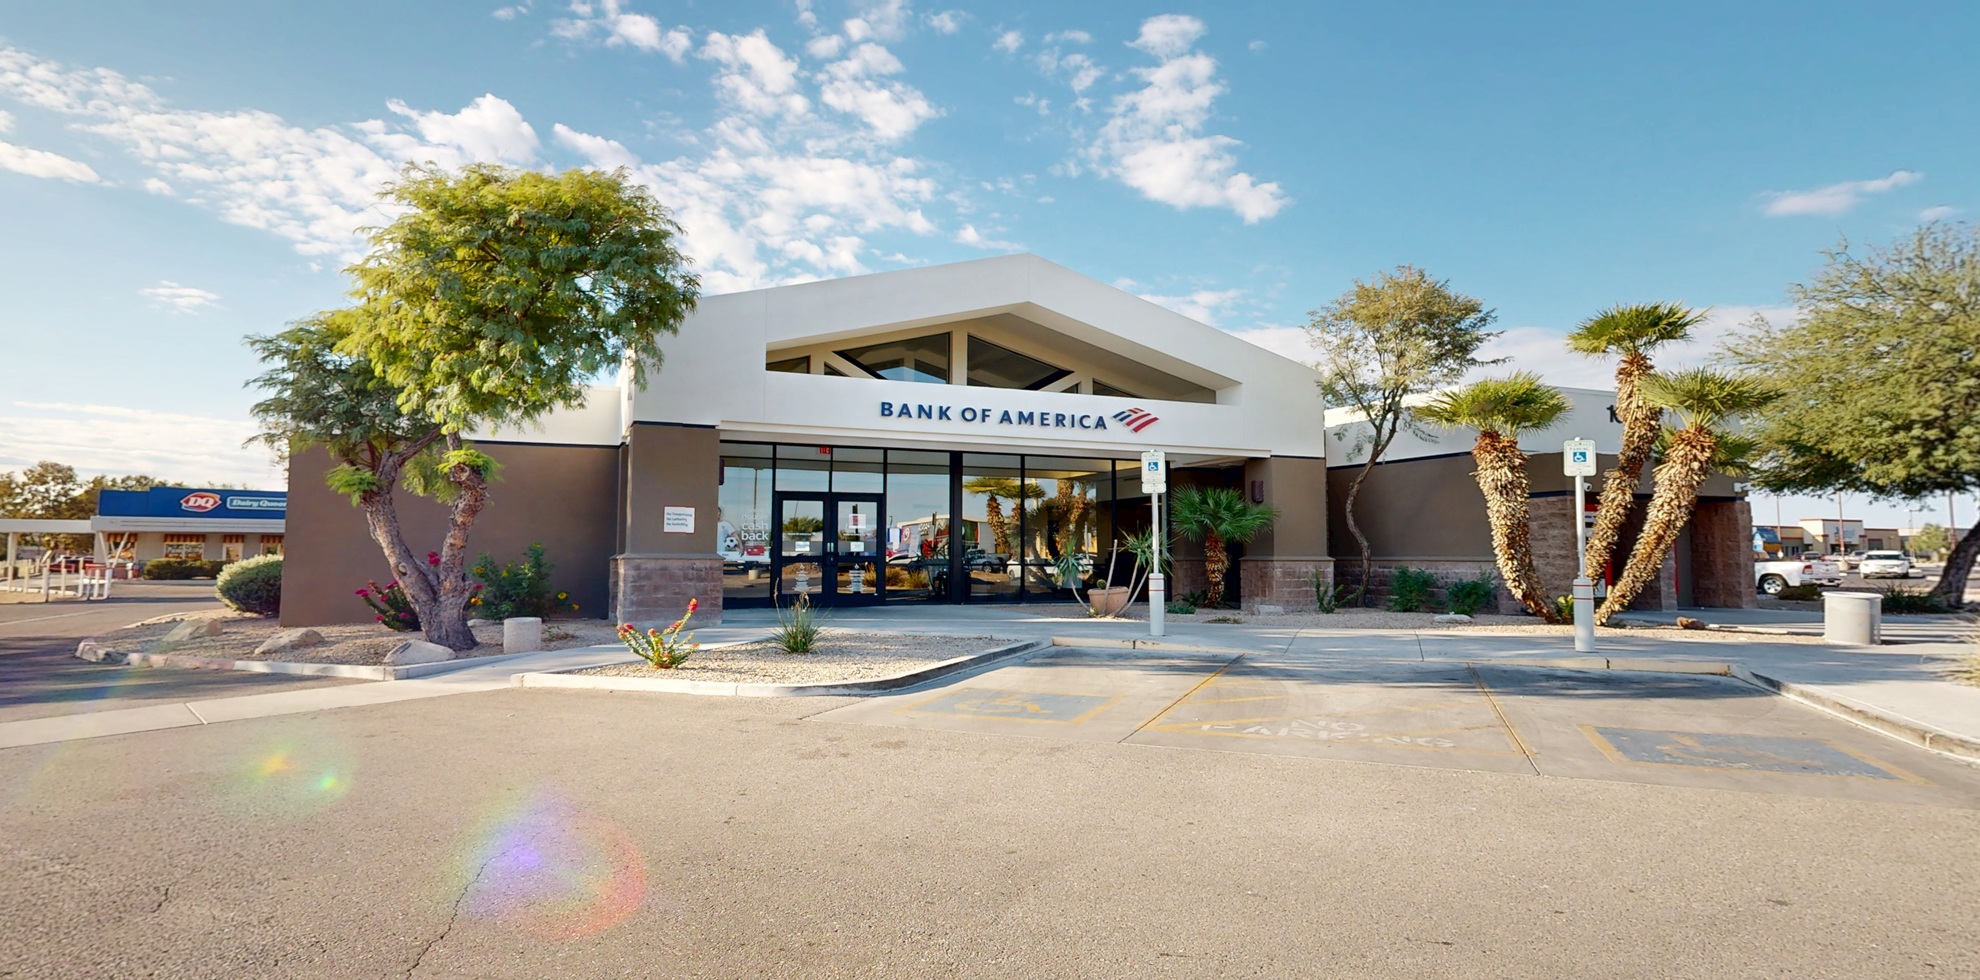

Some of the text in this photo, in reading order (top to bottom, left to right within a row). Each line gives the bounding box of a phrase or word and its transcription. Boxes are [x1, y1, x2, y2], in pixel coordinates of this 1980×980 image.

[880, 401, 1108, 430] BANK OF AMERICA
[188, 497, 214, 508] DQ
[232, 499, 259, 507] Dairy
[741, 521, 769, 530] cash
[741, 530, 769, 540] back
[1290, 718, 1366, 732] NO
